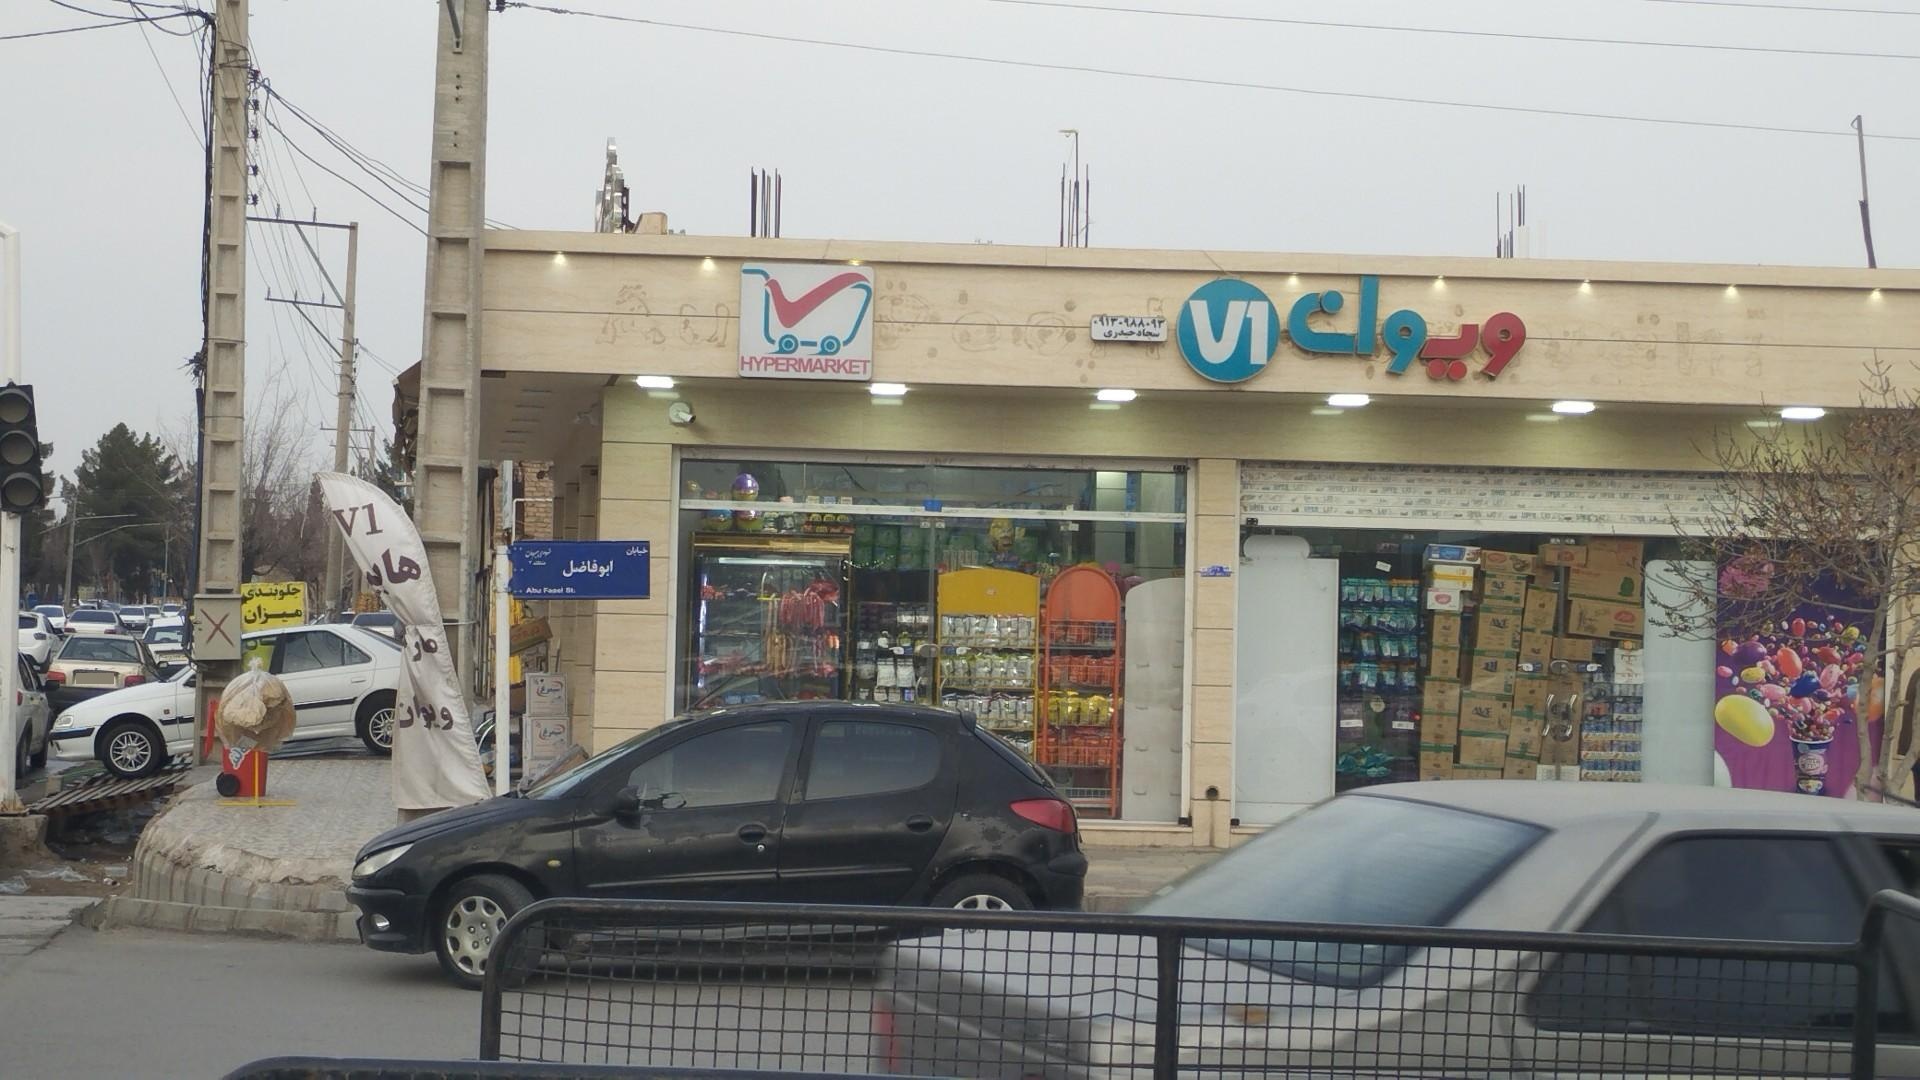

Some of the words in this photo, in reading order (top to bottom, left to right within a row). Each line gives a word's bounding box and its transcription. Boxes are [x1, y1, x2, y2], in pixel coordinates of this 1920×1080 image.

[741, 356, 870, 375] HYPERMARKET
[333, 503, 383, 538] V1
[625, 546, 648, 556] خیابان
[562, 560, 614, 577] ابوفاضل
[242, 584, 301, 604] جلوبندی
[526, 586, 542, 594] Abu
[244, 604, 303, 624] میزان
